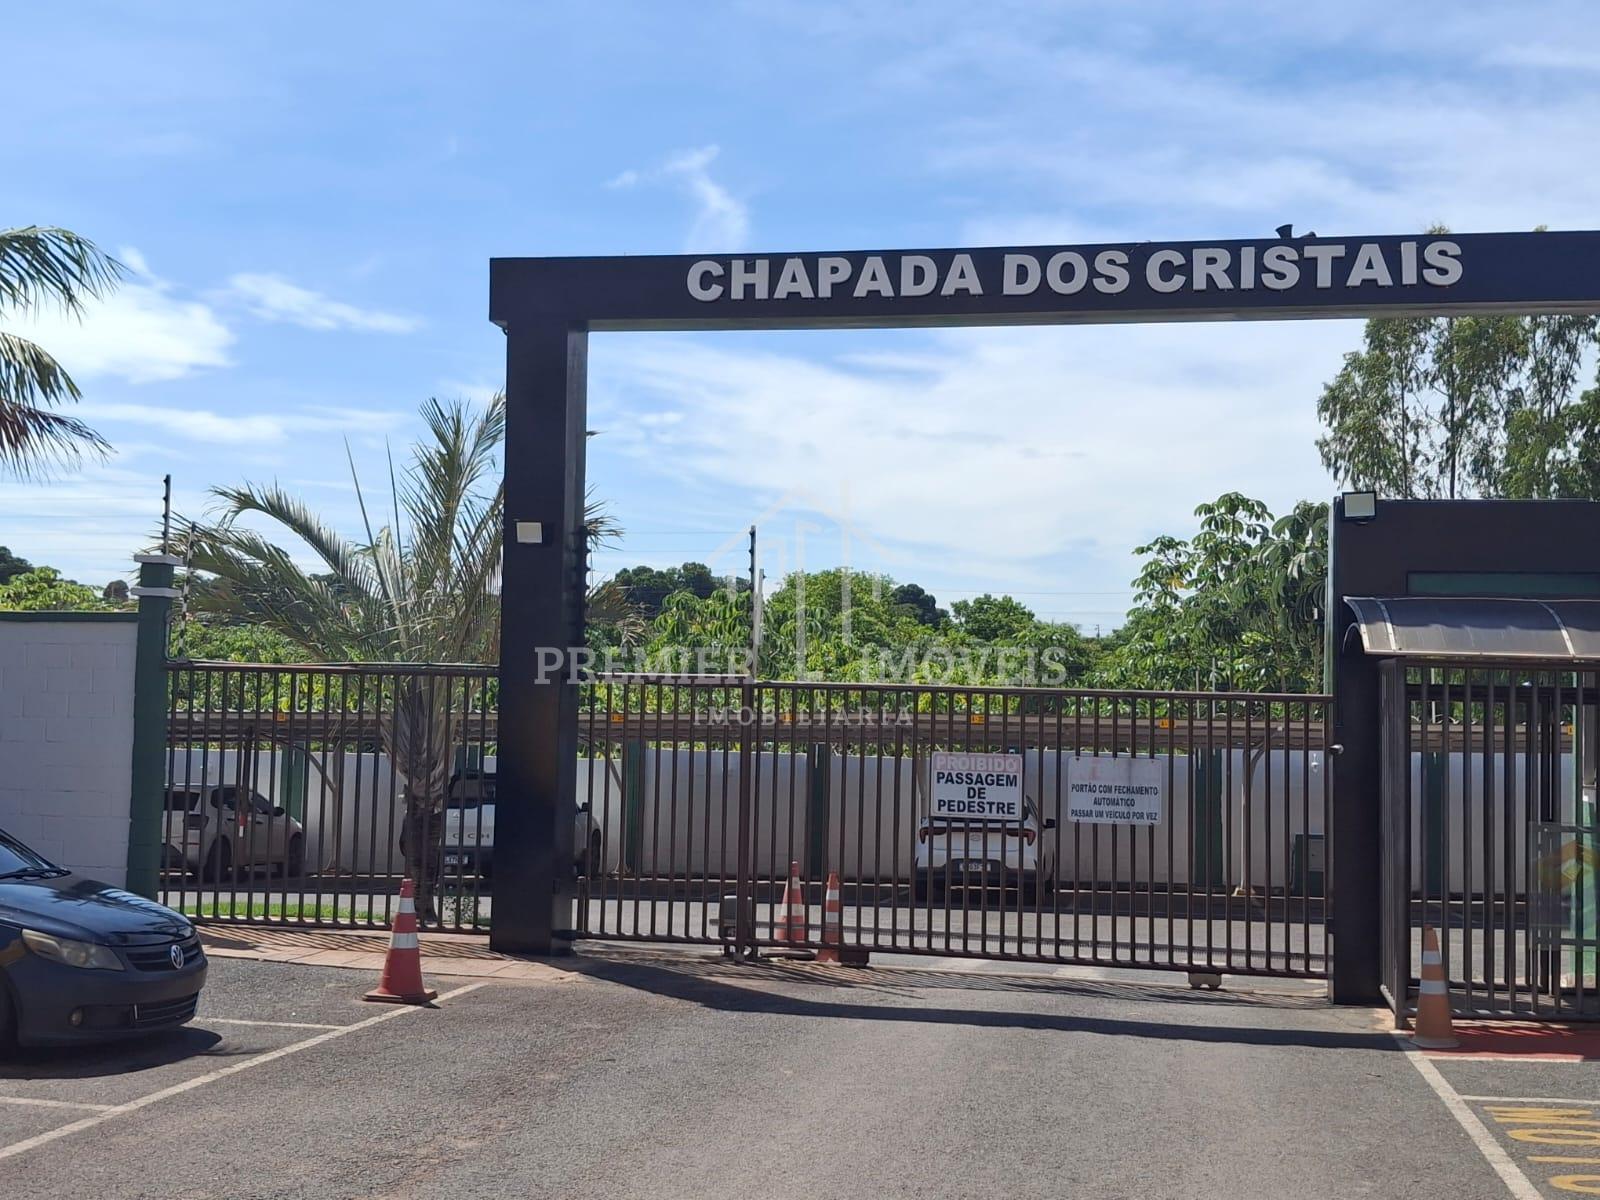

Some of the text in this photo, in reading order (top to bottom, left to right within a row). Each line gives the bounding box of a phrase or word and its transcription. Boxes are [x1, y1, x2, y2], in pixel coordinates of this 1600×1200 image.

[687, 241, 1464, 301] CHAPADA DOS CRISTAIS
[936, 756, 1018, 772] PROIBIDO
[936, 771, 1017, 787] PASSAGEM
[967, 786, 986, 800] DE
[1071, 782, 1158, 796] PORTÃO COM FECHAMENTO
[937, 799, 1016, 815] PEDESTRE
[1071, 809, 1093, 818] PASSAR
[1094, 810, 1104, 818] UM
[1132, 811, 1145, 820] POR
[1146, 812, 1158, 820] VEZ
